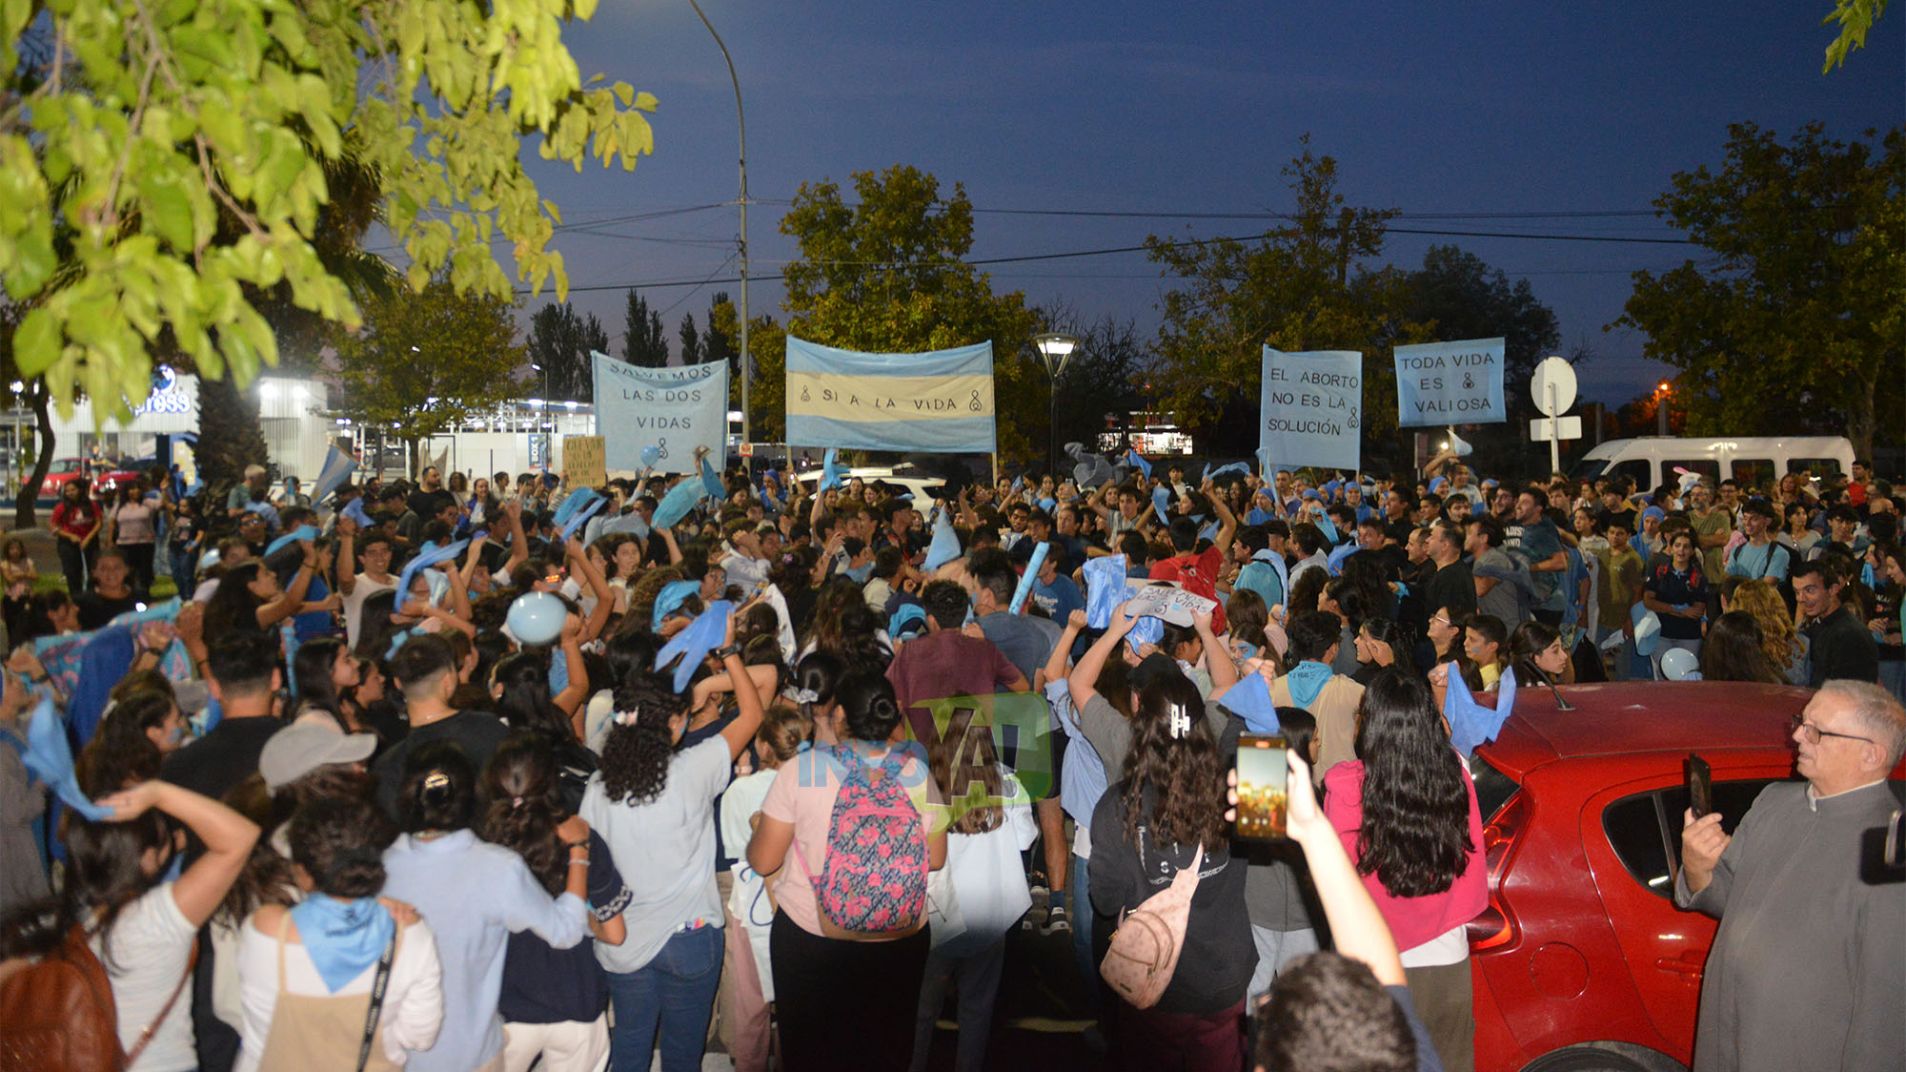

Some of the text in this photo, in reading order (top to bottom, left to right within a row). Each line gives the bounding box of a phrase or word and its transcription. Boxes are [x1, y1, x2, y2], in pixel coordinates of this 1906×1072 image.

[1401, 352, 1494, 370] TODA VIDA
[1270, 368, 1359, 389] EL ABORTO
[1420, 378, 1443, 390] ES
[623, 388, 702, 402] LAS DOS
[822, 389, 957, 411] SI A LA VIDA
[1272, 392, 1346, 410] NO ES LA
[1414, 397, 1492, 413] VALIOSA
[637, 416, 691, 429] VIDAS
[1268, 418, 1341, 436] SOLUCIÓN
[531, 443, 539, 463] BOX
